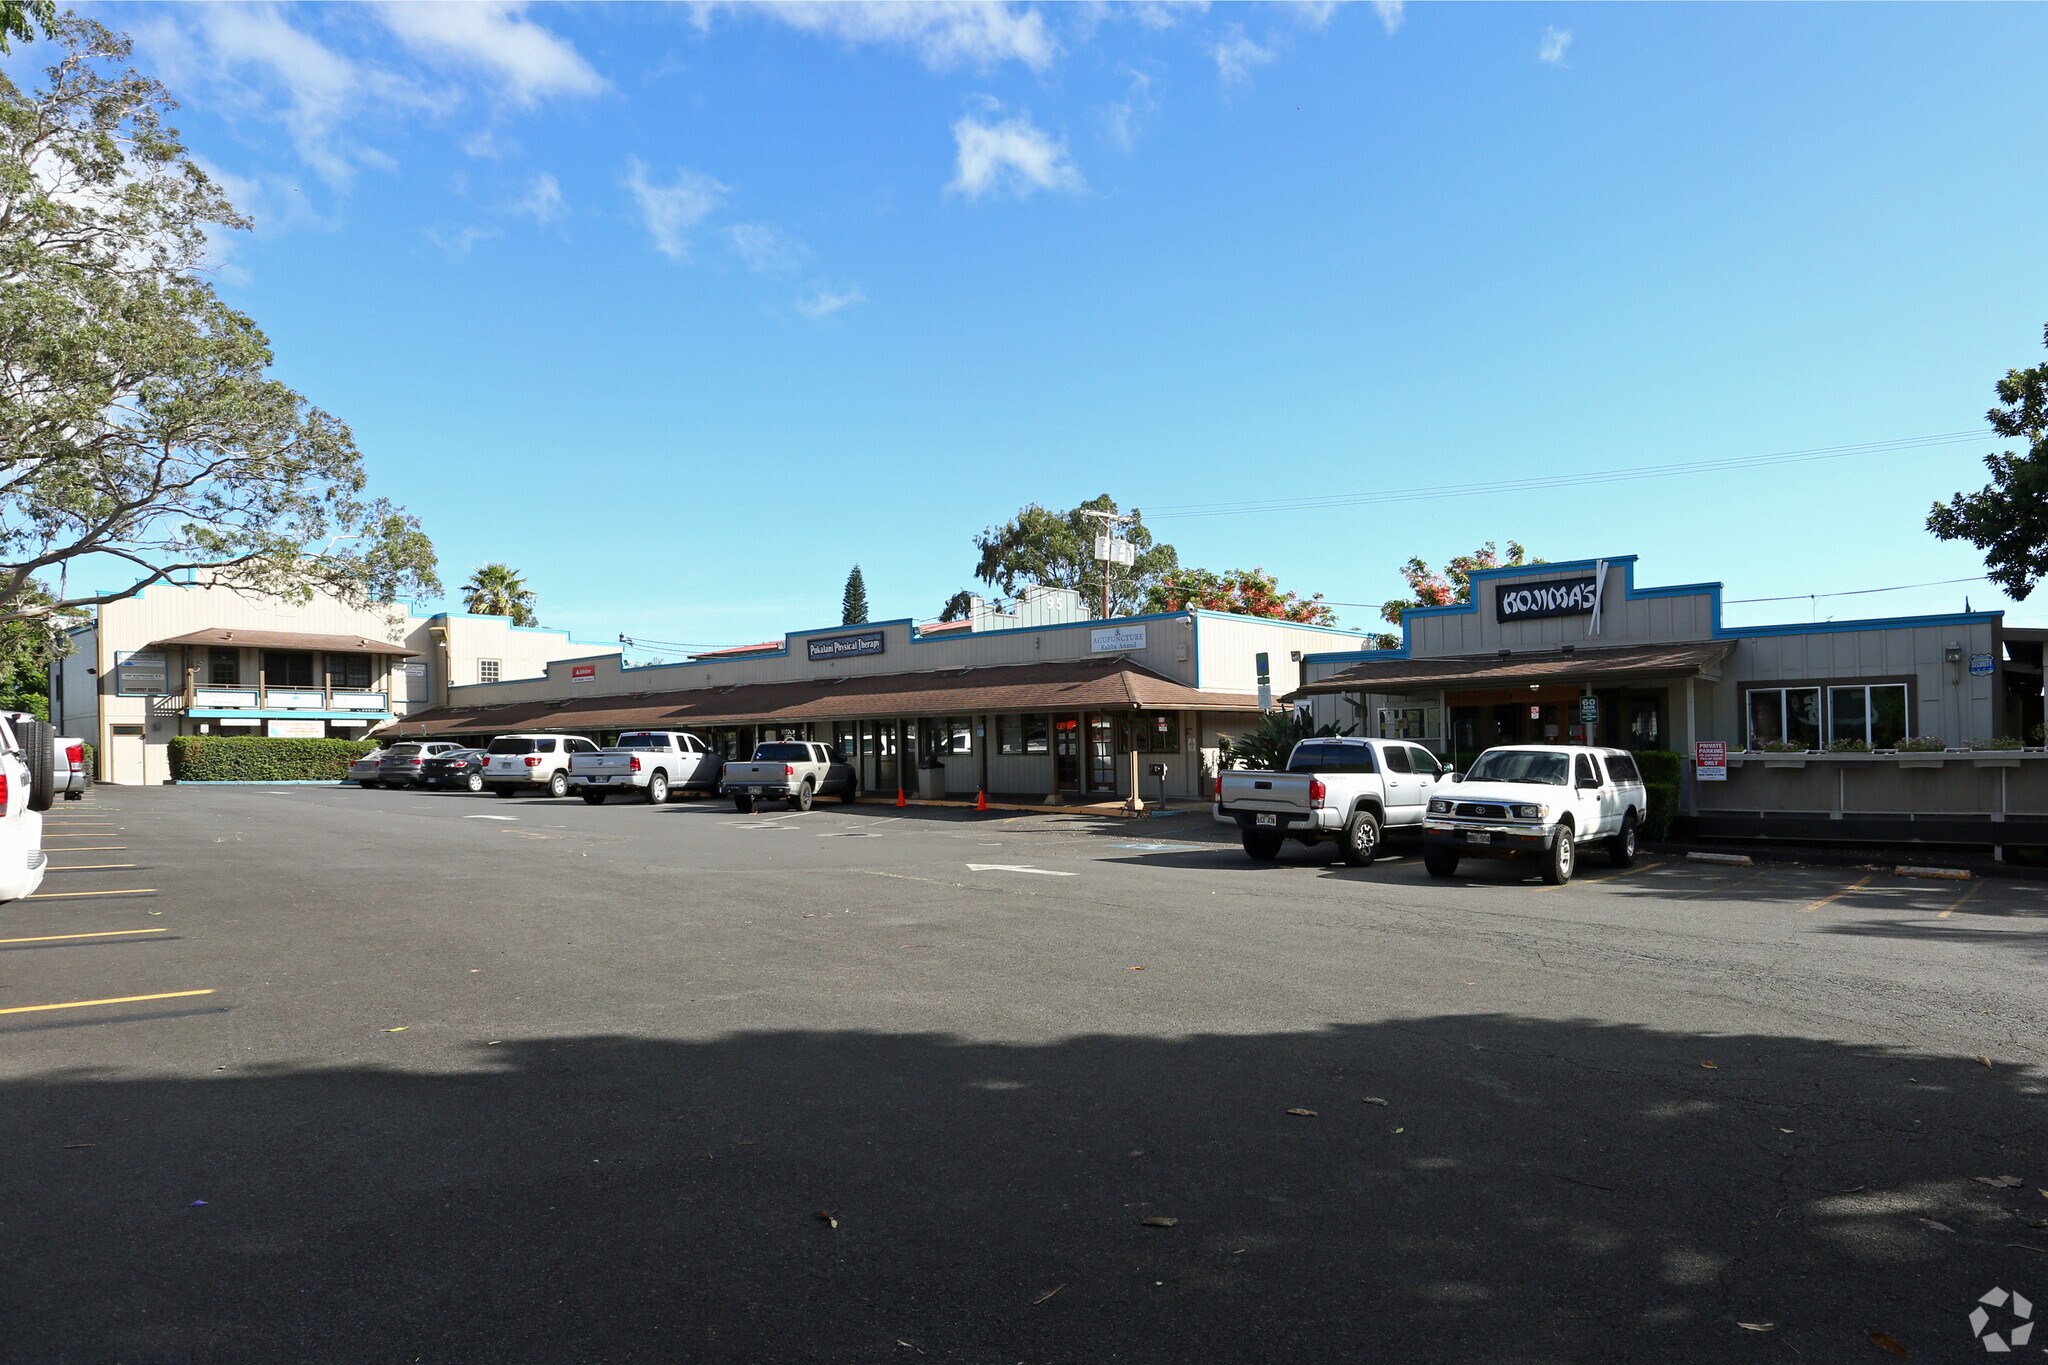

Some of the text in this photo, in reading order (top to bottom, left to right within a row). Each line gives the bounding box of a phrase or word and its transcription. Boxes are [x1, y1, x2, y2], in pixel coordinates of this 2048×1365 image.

[1046, 595, 1063, 611] 95
[1503, 583, 1596, 615] KOJIMA'S
[1094, 633, 1144, 644] ACUPUNCTURE
[810, 638, 880, 656] Pukalani Physical Therapy
[1582, 698, 1596, 706] 60
